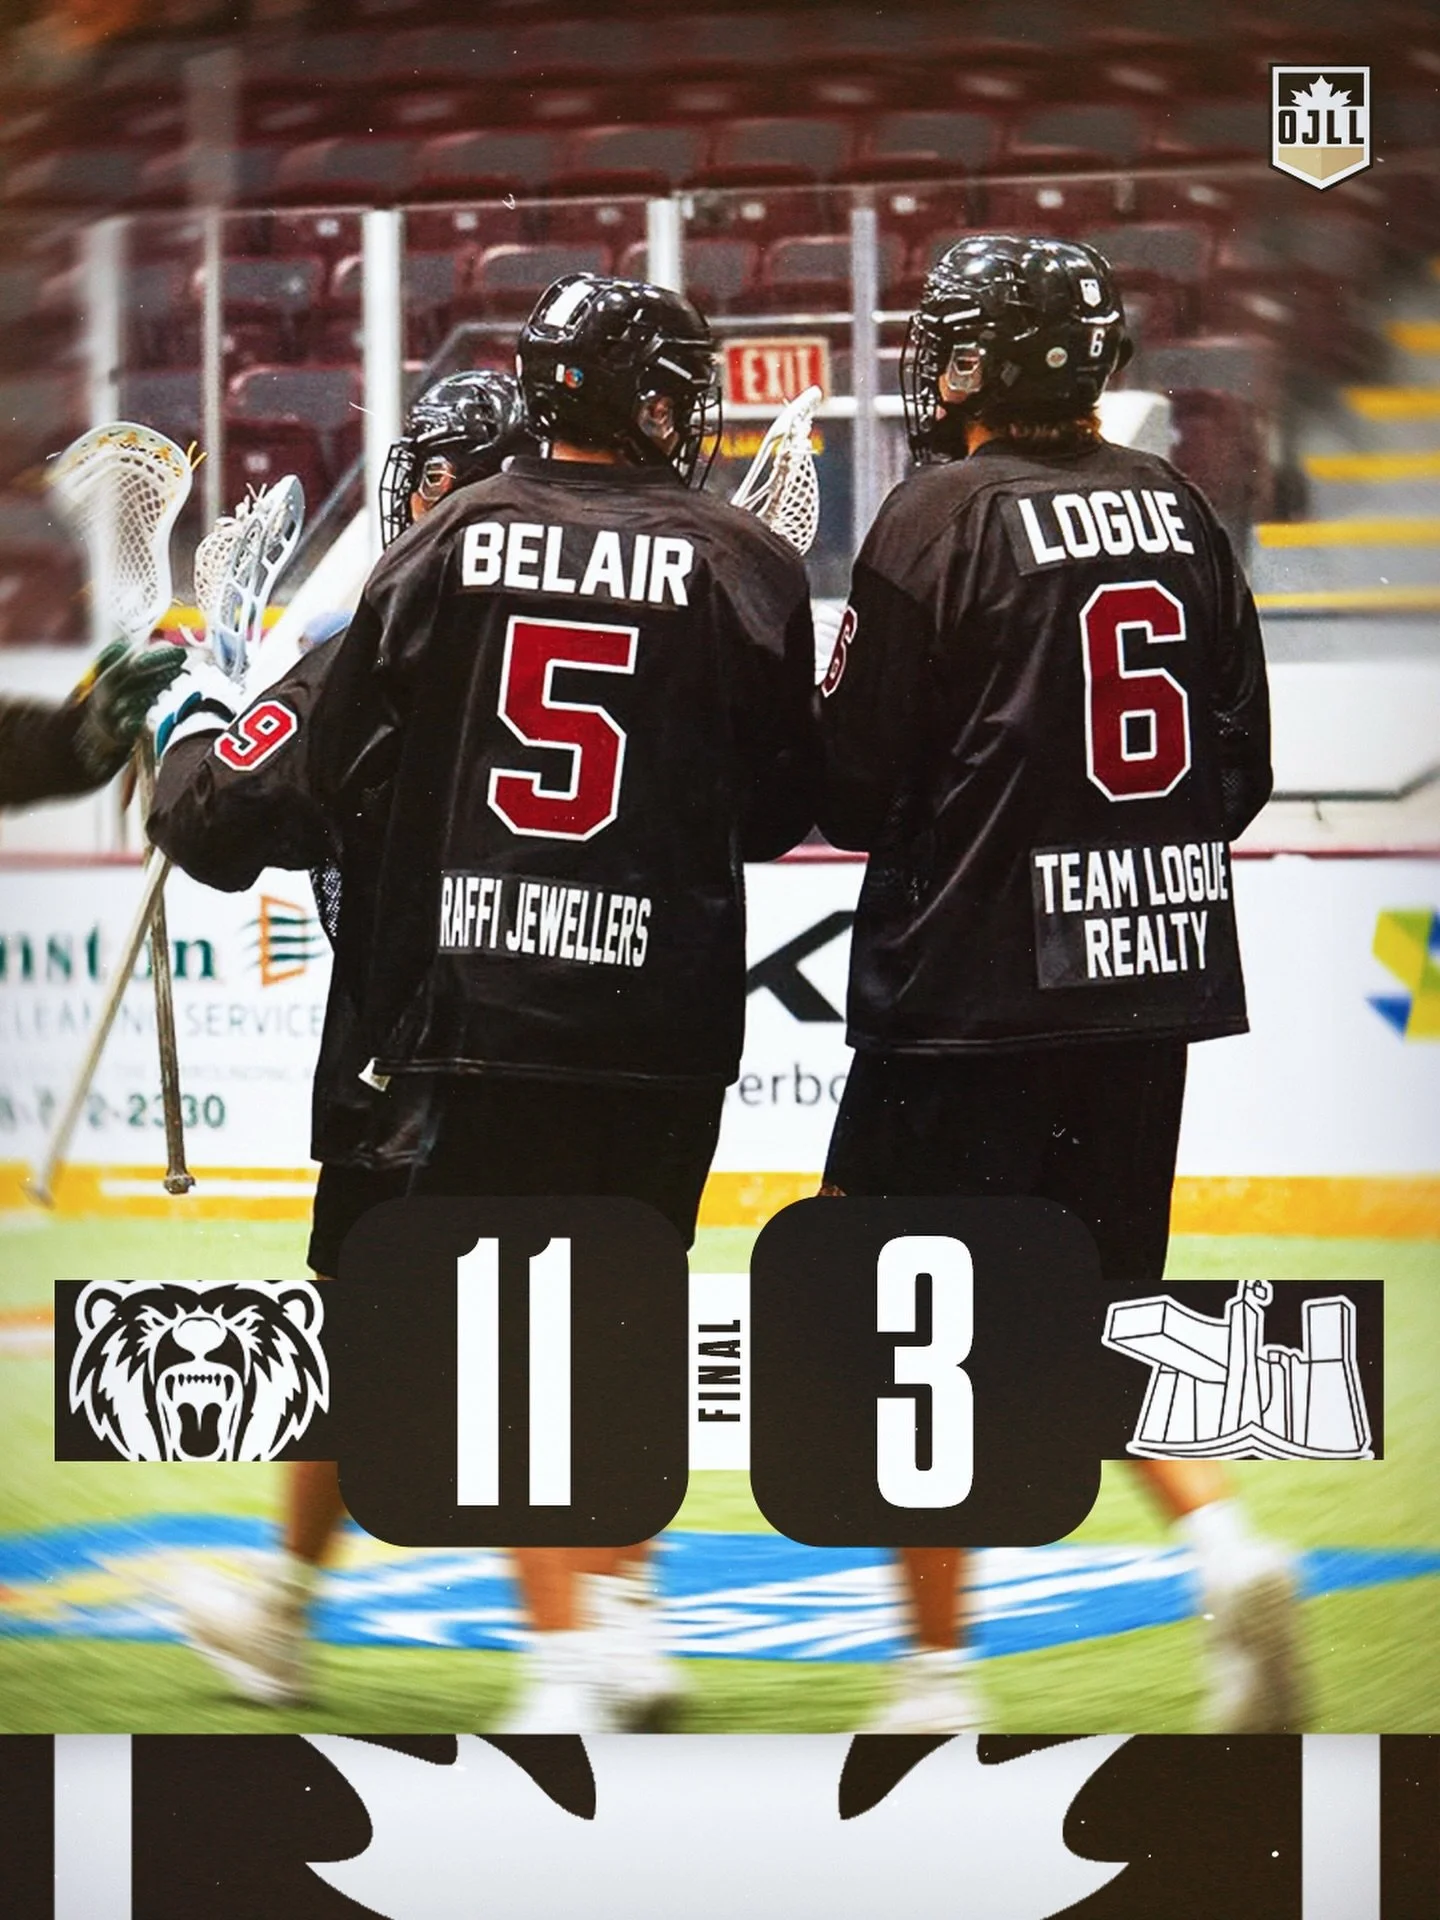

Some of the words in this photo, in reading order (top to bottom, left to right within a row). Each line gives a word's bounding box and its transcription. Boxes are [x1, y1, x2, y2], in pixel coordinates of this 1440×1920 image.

[742, 348, 811, 402] EXIT
[1090, 327, 1105, 357] 6
[462, 521, 694, 606] BELAIR
[1018, 490, 1195, 565] LOGUE
[487, 615, 639, 841] 5
[1080, 580, 1191, 802] 6
[214, 700, 298, 771] 9
[1034, 846, 1138, 914] TEAM
[1143, 841, 1229, 905] LOGUE
[440, 876, 502, 949] RAFFI
[505, 883, 652, 967] JEWELLERS
[1083, 911, 1209, 979] REALTY
